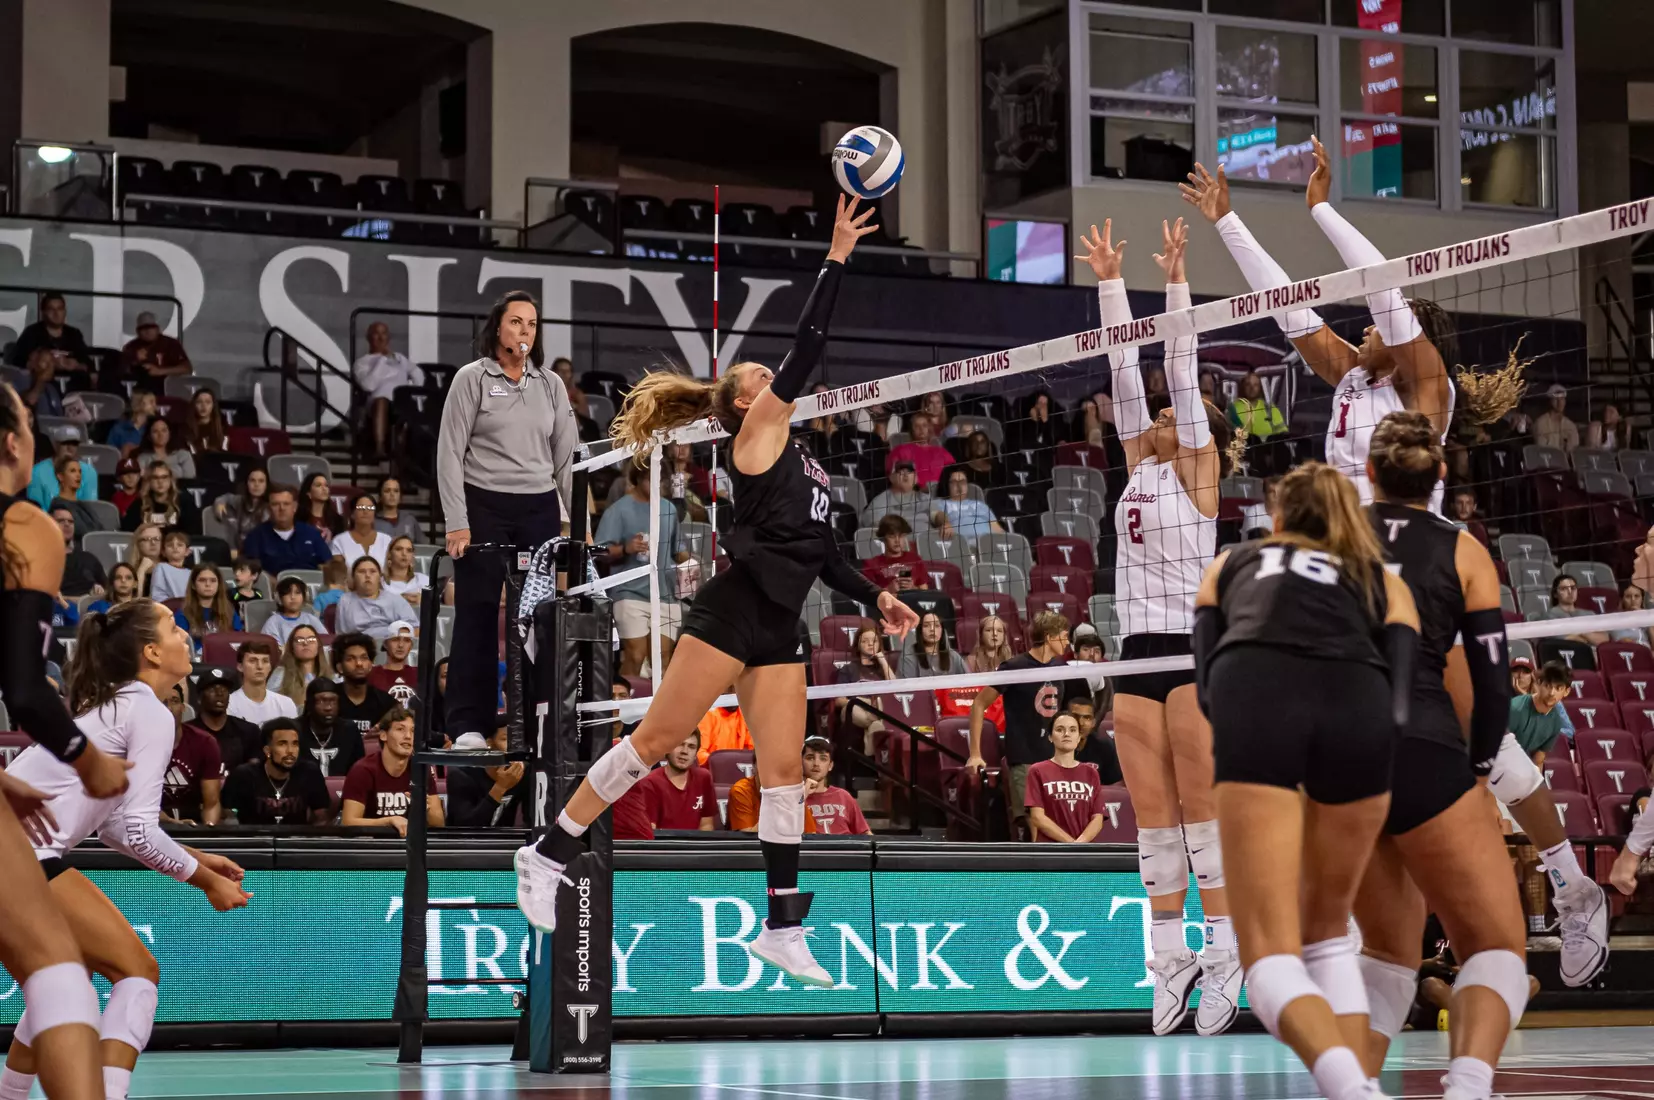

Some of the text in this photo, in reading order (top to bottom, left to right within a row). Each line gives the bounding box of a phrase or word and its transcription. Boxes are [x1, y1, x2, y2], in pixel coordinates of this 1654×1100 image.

[1608, 201, 1649, 231] TROY
[1406, 234, 1510, 277] TROY TROJANS
[1230, 279, 1321, 318] TROY TROJANS
[1075, 317, 1156, 352] TROY TROJANS
[938, 351, 1010, 384] TROY TROJANS
[816, 381, 880, 411] TROY TROJANS
[1128, 508, 1144, 544] 2
[1254, 547, 1343, 585] 16
[1043, 781, 1094, 797] TROY
[126, 824, 184, 872] TROJANS
[384, 896, 656, 994] TRY
[688, 895, 974, 991] BNK
[1004, 904, 1089, 990] &
[577, 877, 592, 992] sports imports
